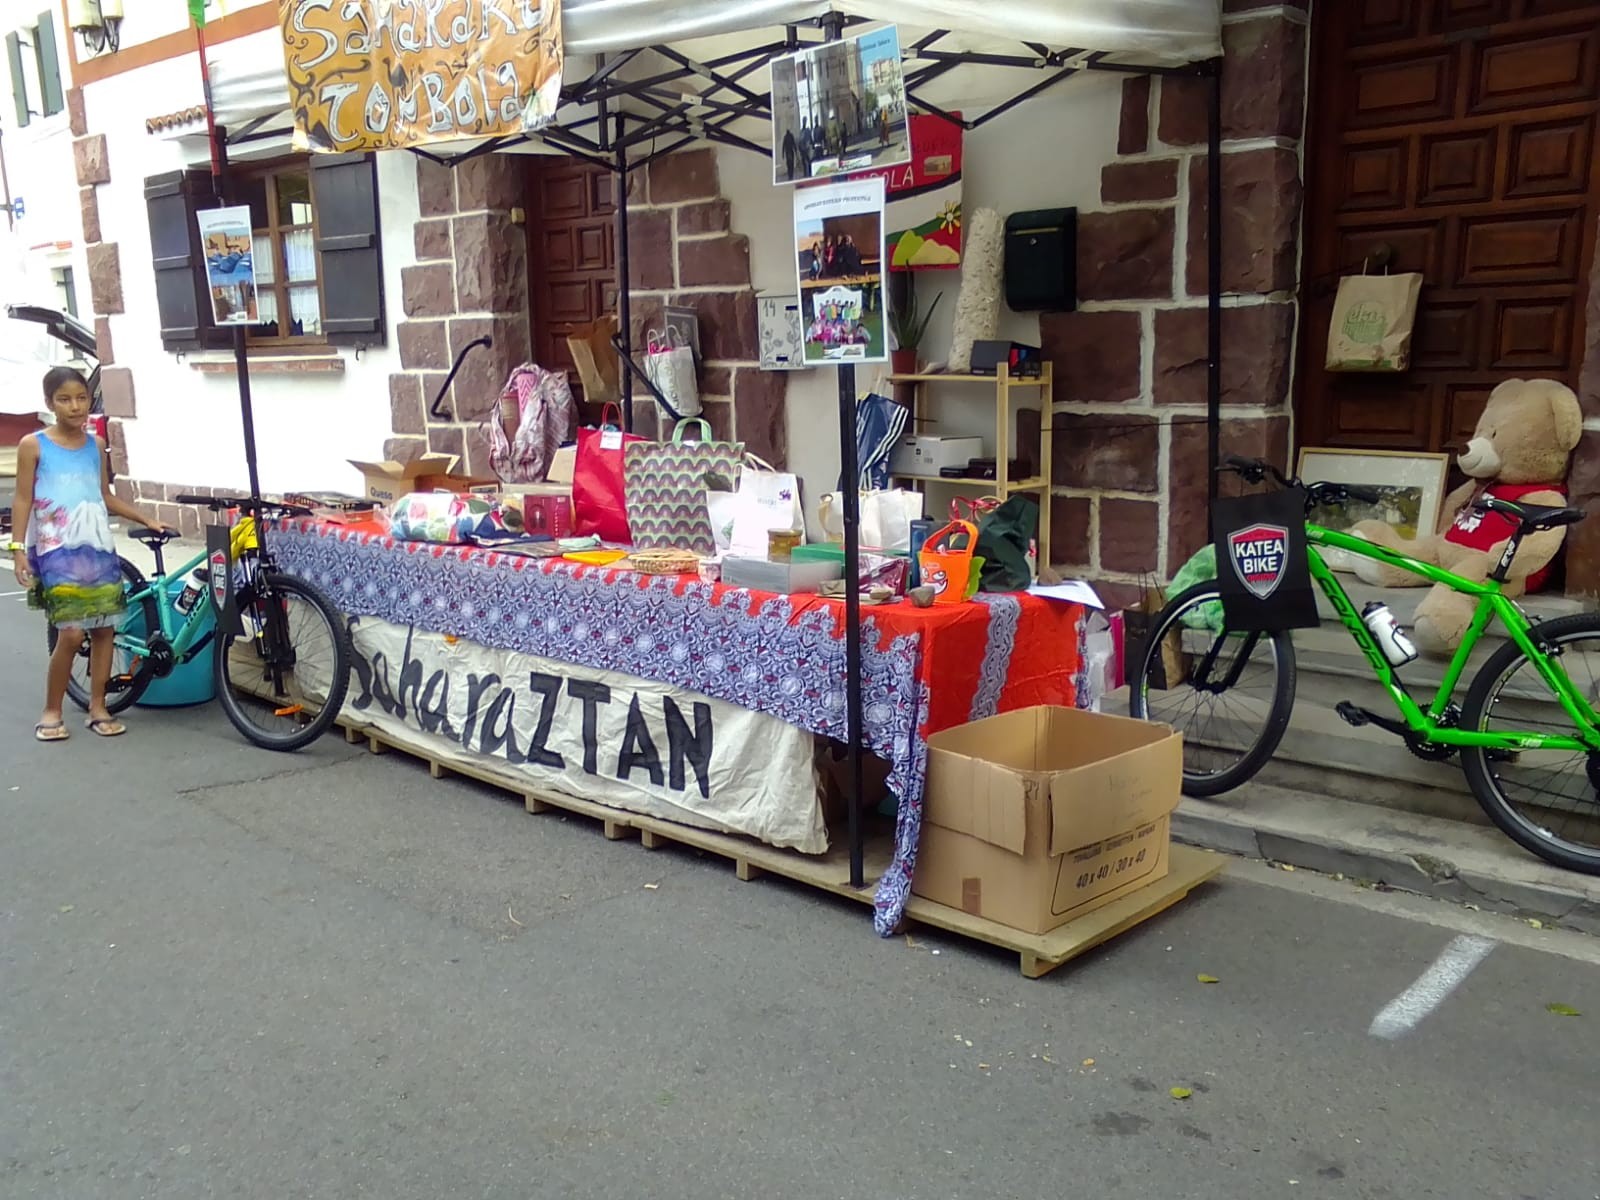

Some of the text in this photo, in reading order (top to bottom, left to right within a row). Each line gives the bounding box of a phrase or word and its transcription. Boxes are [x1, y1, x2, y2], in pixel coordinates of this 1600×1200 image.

[1235, 538, 1284, 558] KATEA
[1243, 556, 1278, 574] BIKE
[1076, 873, 1089, 889] 40
[1097, 864, 1109, 880] 40
[1116, 857, 1128, 873] 30
